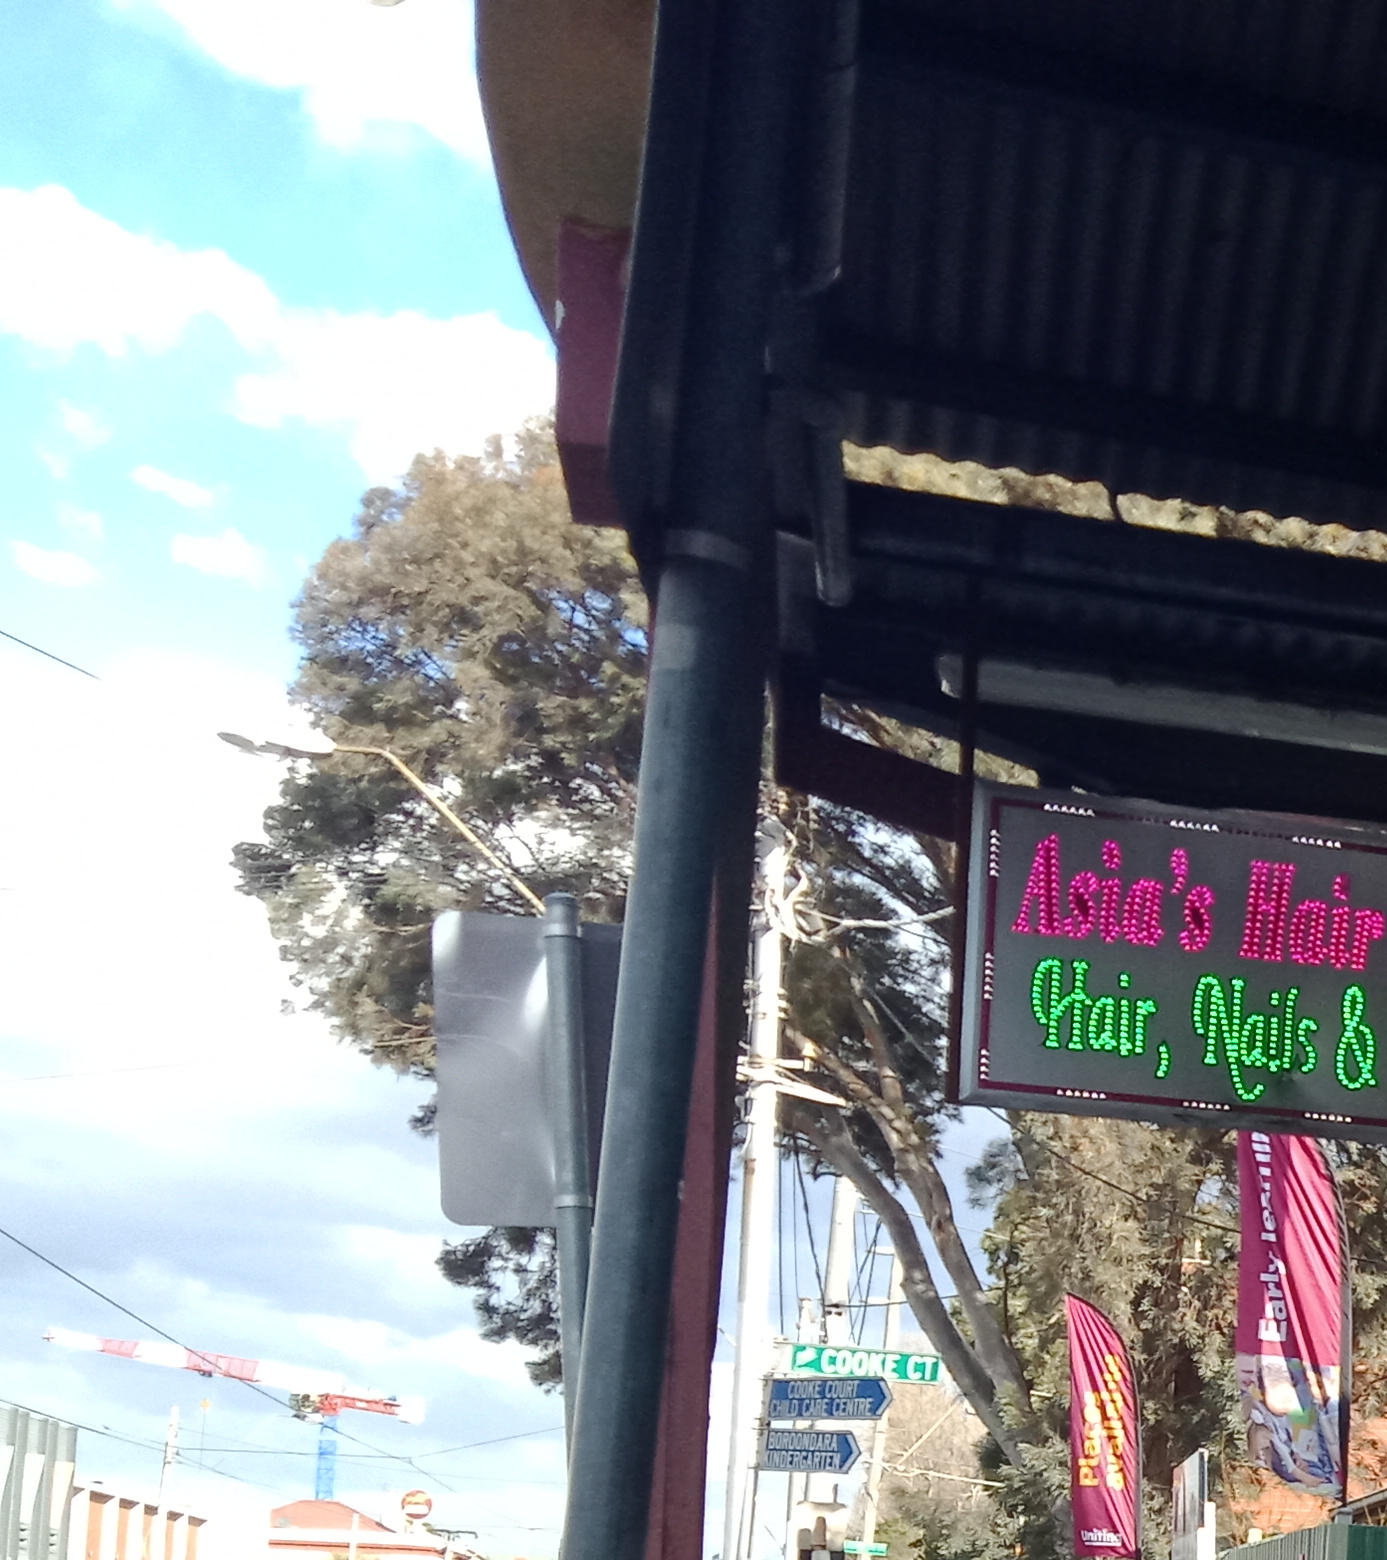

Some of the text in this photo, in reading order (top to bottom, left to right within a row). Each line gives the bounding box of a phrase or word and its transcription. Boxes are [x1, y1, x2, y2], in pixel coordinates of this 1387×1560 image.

[1011, 832, 1214, 953] Asia's
[1237, 858, 1386, 971] Hair
[1030, 957, 1171, 1081] Hair,
[1192, 973, 1319, 1101] Nails
[1335, 983, 1377, 1090] &
[1258, 1251, 1287, 1344] Early
[820, 1348, 938, 1381] COOKE CT
[788, 1380, 860, 1399] COOKE COURT
[770, 1398, 875, 1417] CHILD CARE CENTRE
[767, 1431, 838, 1452] BOROONDARA
[763, 1450, 842, 1471] KINDERGARTEN
